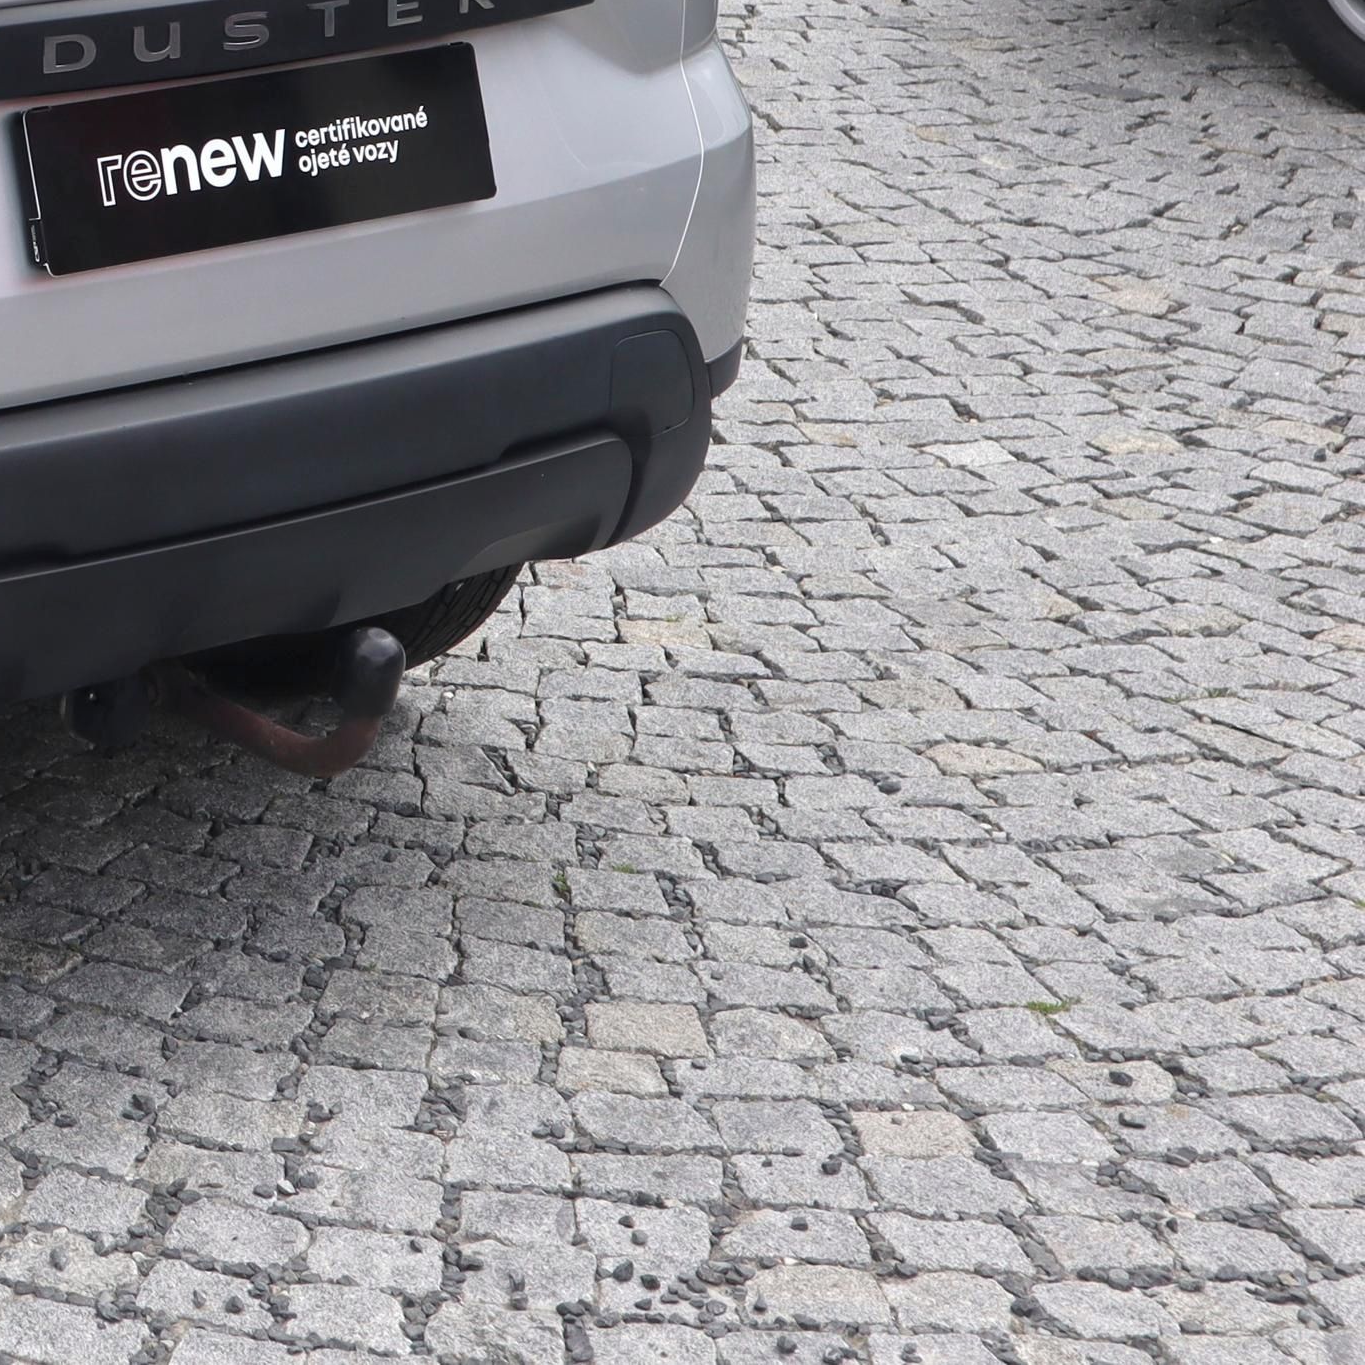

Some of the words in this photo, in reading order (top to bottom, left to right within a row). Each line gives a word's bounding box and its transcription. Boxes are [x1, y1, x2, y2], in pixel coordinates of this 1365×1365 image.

[295, 106, 429, 148] certifikované
[97, 128, 286, 207] renew
[299, 145, 350, 177] ojeté
[355, 138, 400, 165] vozy
